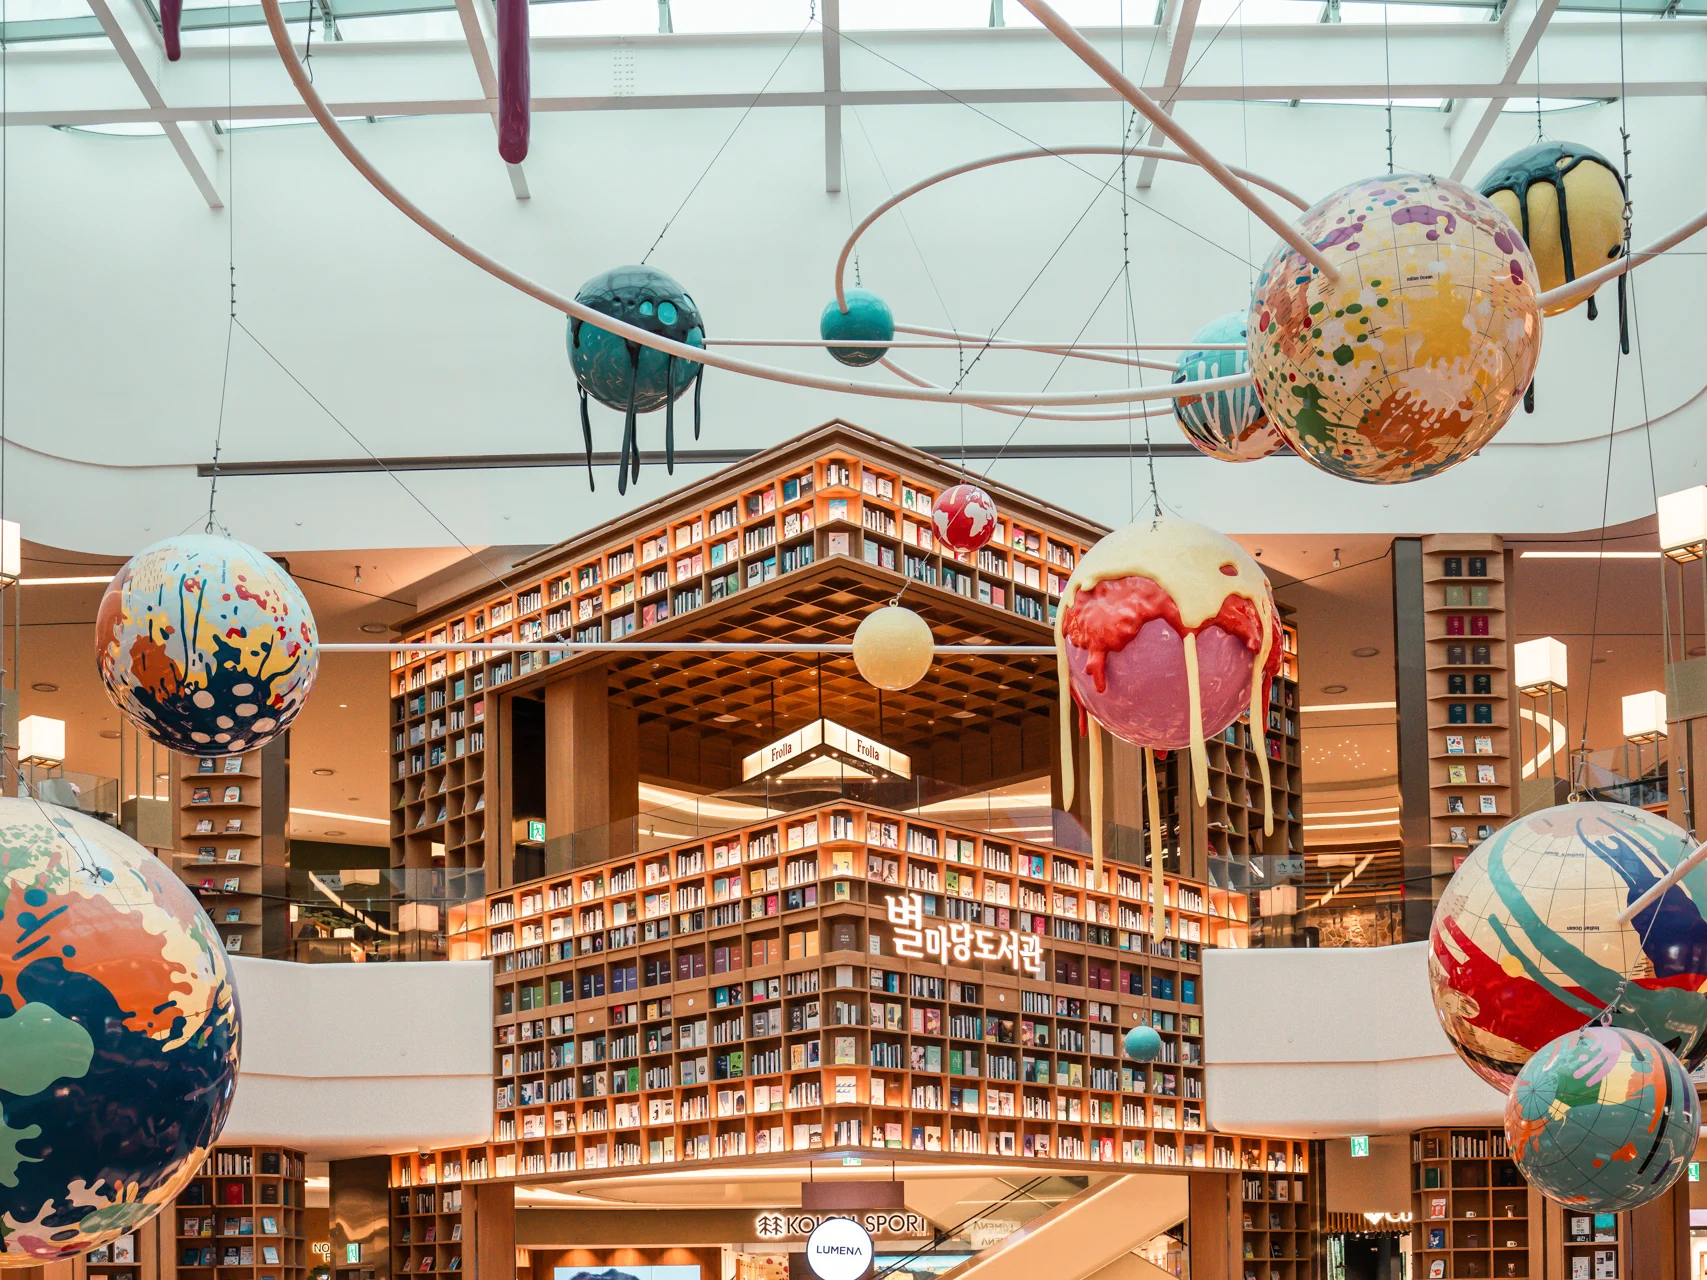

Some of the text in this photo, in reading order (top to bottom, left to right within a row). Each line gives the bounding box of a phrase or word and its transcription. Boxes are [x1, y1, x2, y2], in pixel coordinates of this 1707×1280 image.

[771, 742, 792, 762] Frolla
[857, 739, 880, 761] Frolla
[885, 893, 1043, 972] 별마당도서관
[816, 1245, 862, 1256] LUMENA
